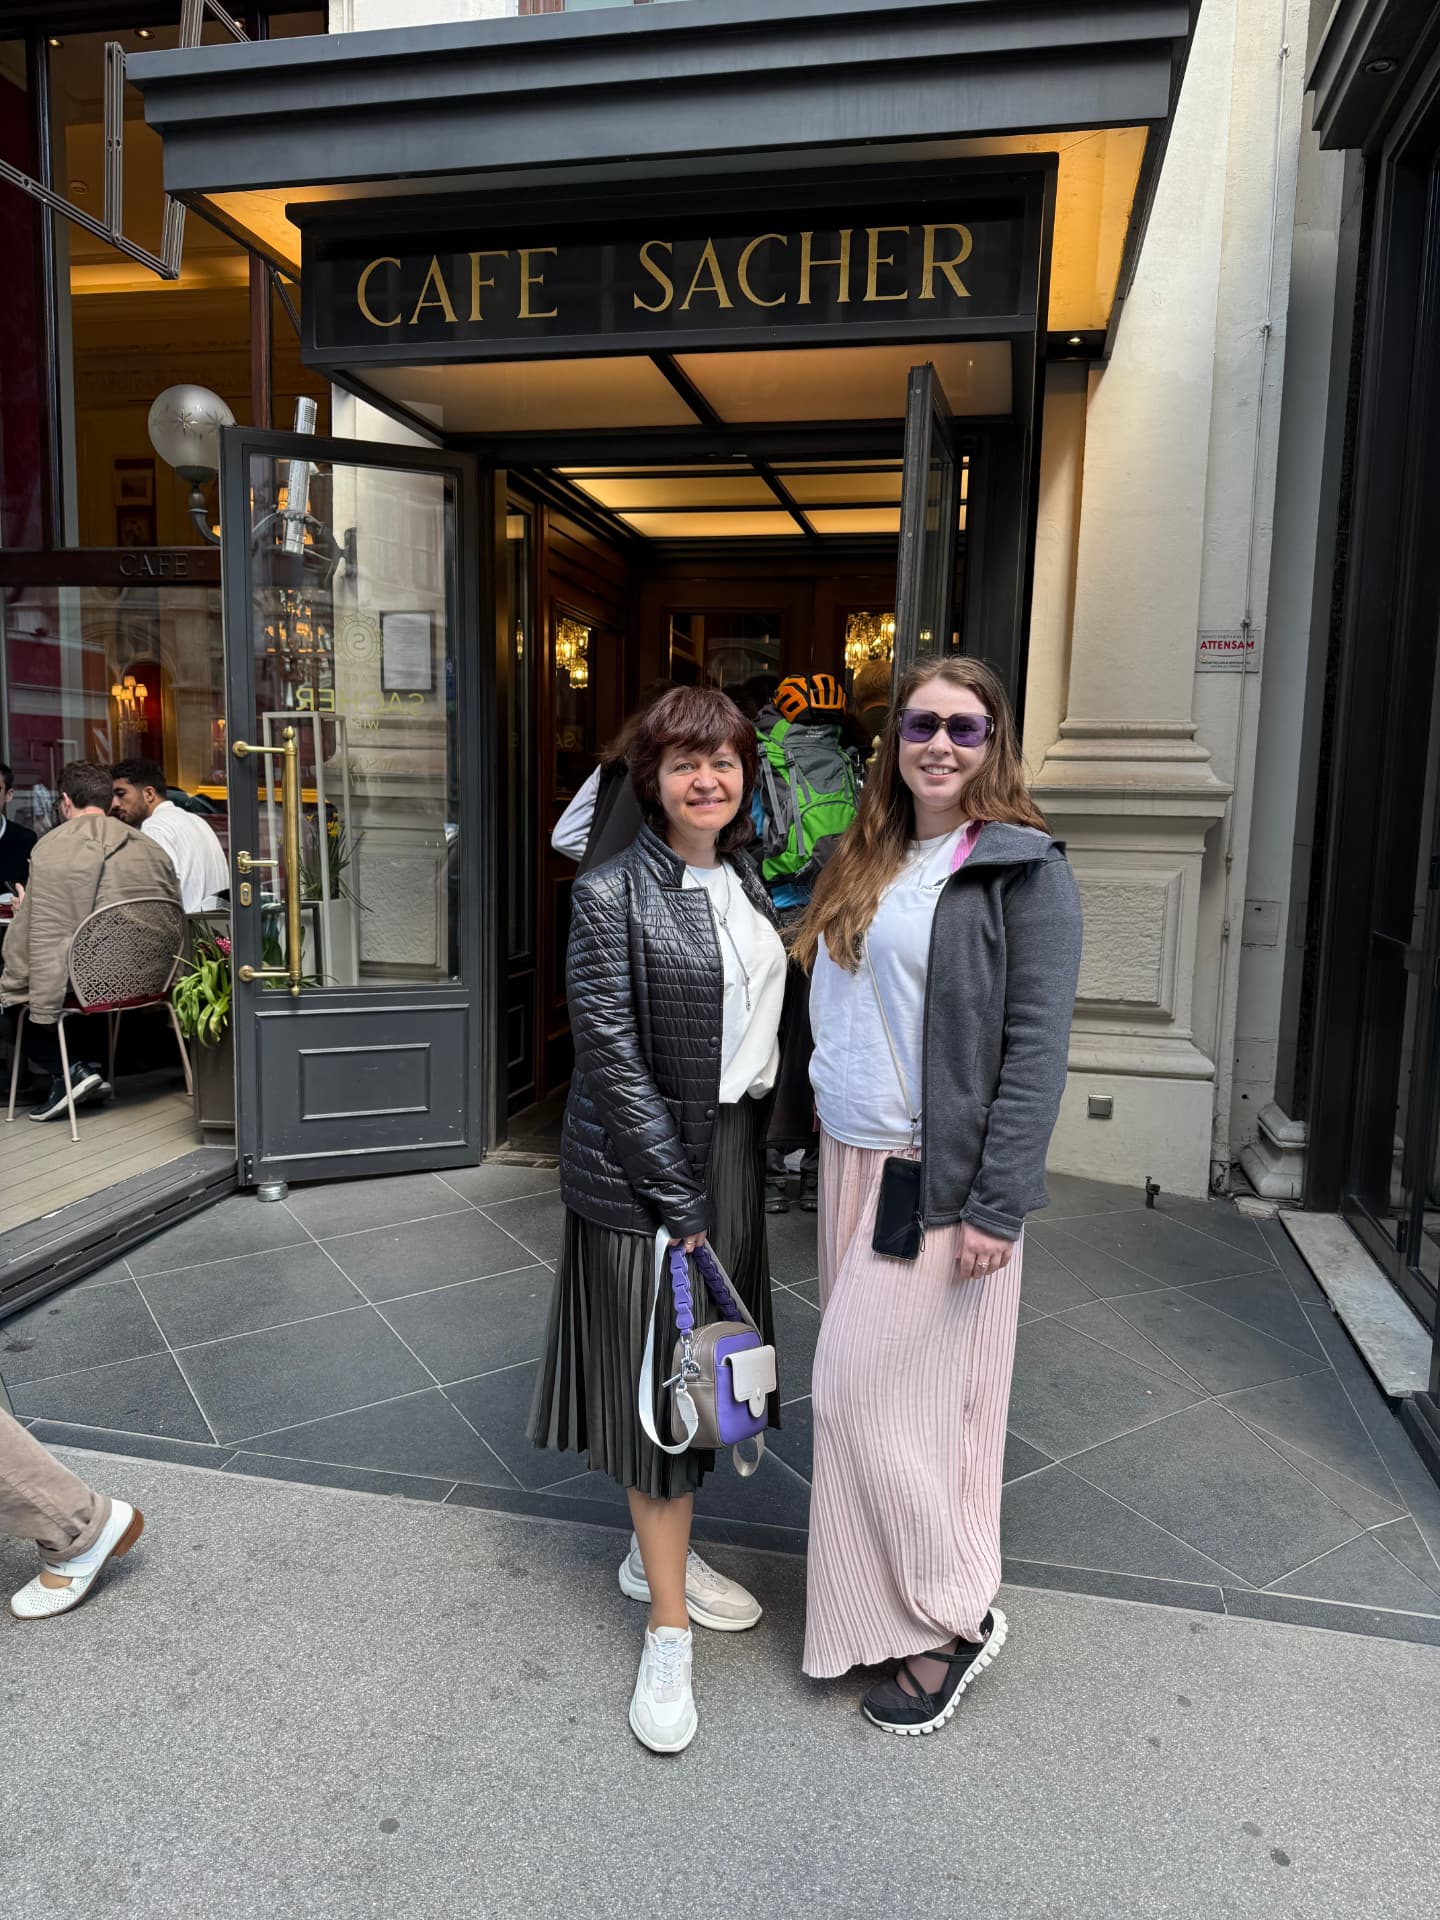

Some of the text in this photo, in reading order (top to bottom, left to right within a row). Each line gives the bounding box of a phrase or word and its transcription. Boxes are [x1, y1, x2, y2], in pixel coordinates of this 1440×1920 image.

[357, 223, 973, 327] CAFE SACHER
[120, 552, 188, 575] CAFE
[1200, 640, 1255, 650] ATTENSAM
